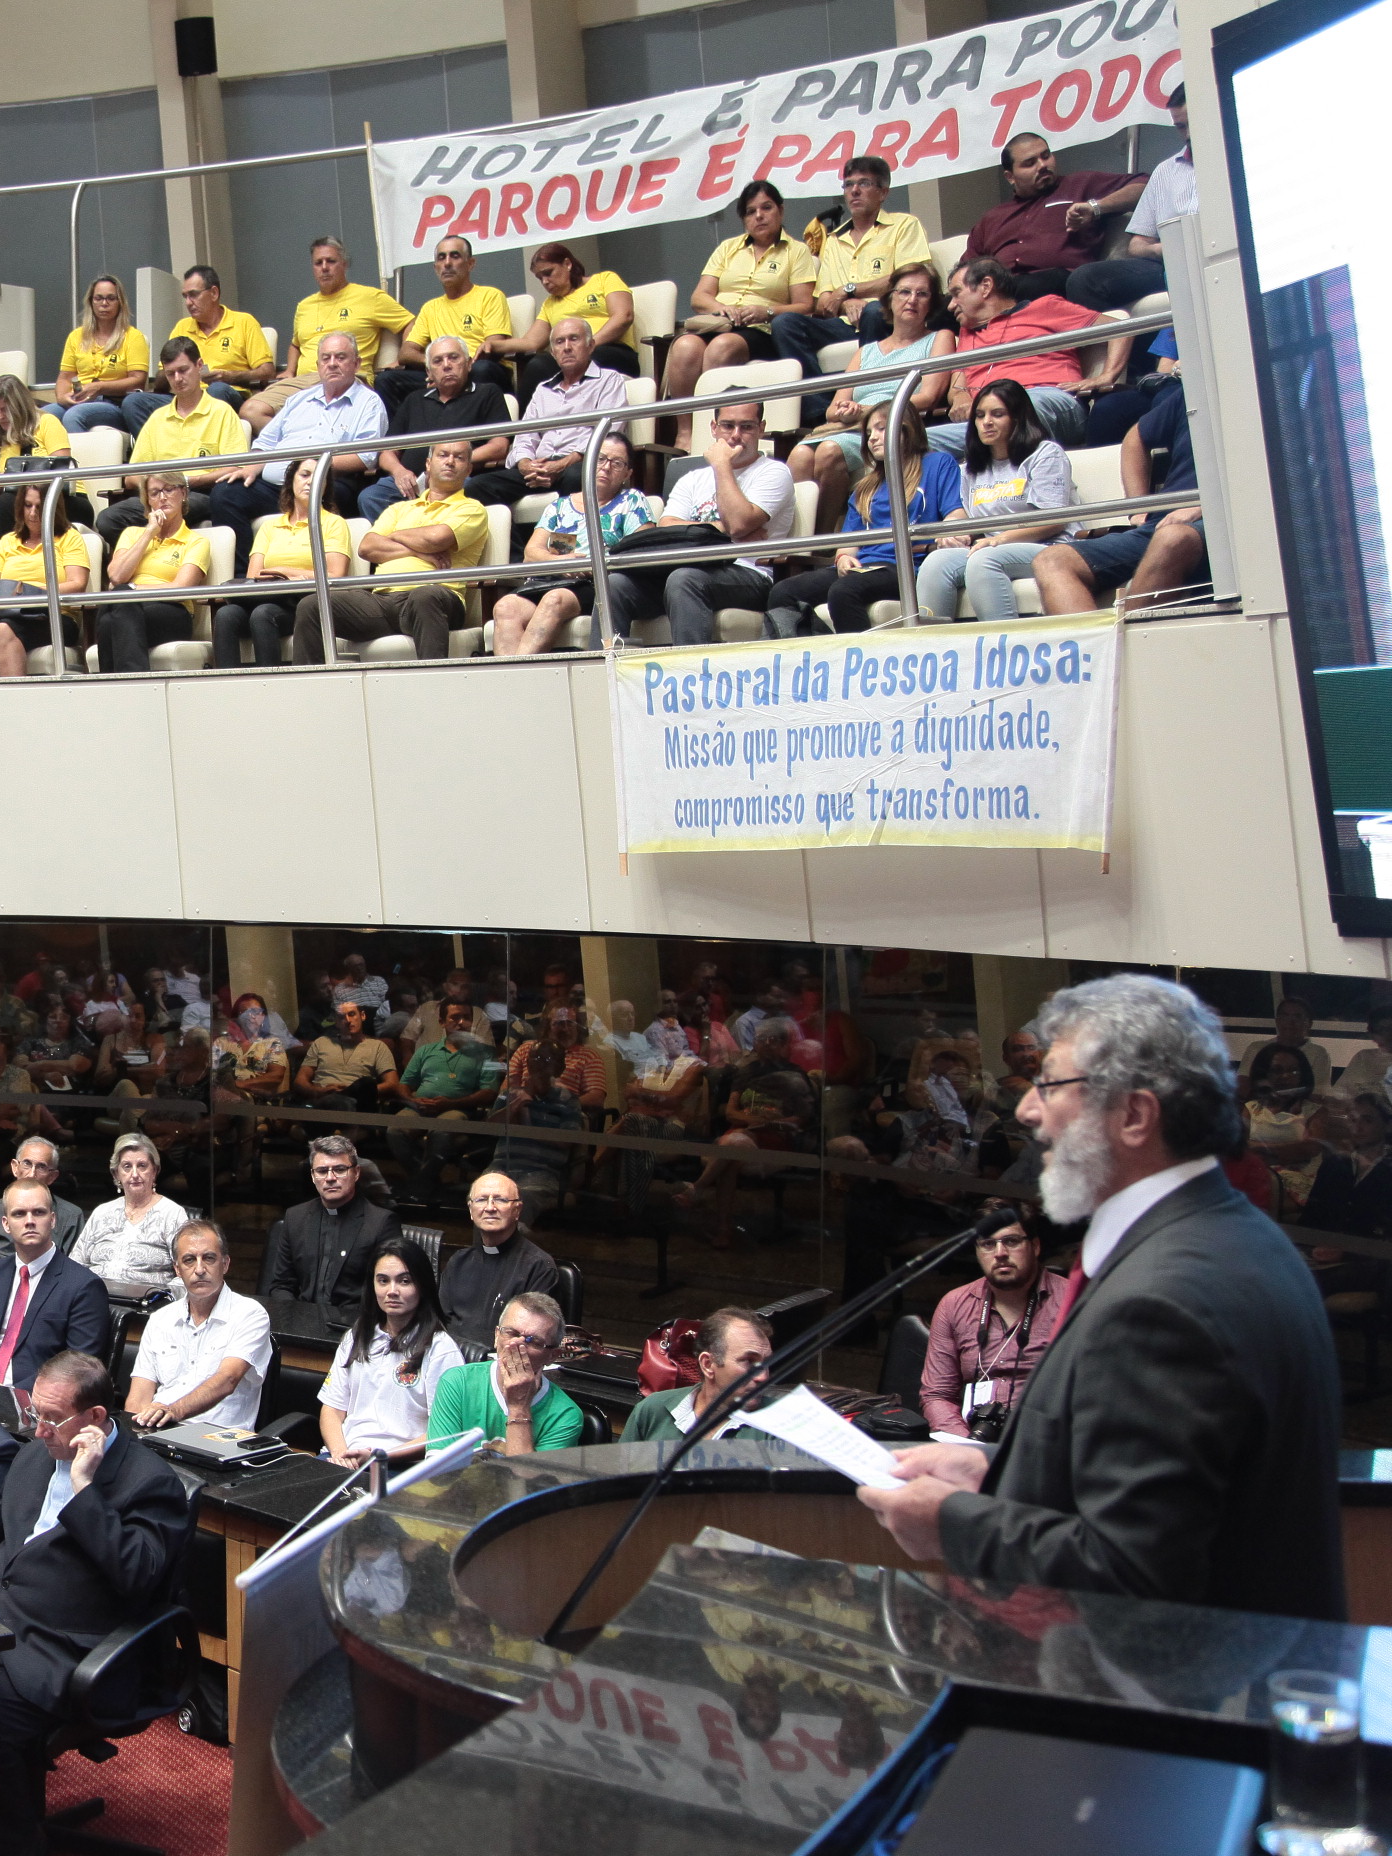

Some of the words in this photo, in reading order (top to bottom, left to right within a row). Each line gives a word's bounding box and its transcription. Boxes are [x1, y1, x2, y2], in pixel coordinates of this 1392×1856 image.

[410, 114, 672, 187] HOTEL
[699, 78, 760, 137] É
[771, 35, 987, 124] PARA
[1004, 0, 1179, 77] POU
[412, 157, 681, 248] PARQUE
[696, 123, 750, 201] É
[752, 107, 960, 183] PARA
[644, 653, 782, 717] Pastoral
[791, 650, 832, 703] da
[841, 645, 959, 700] Pessoa
[971, 634, 1092, 691] Idosa:
[663, 719, 737, 771] Missão
[742, 730, 779, 781] que
[785, 719, 882, 777] promove
[890, 721, 904, 755] a
[913, 697, 1061, 772] dignidade,
[673, 783, 805, 838] compromisso
[815, 788, 855, 837] que
[866, 777, 1041, 824] transforma.
